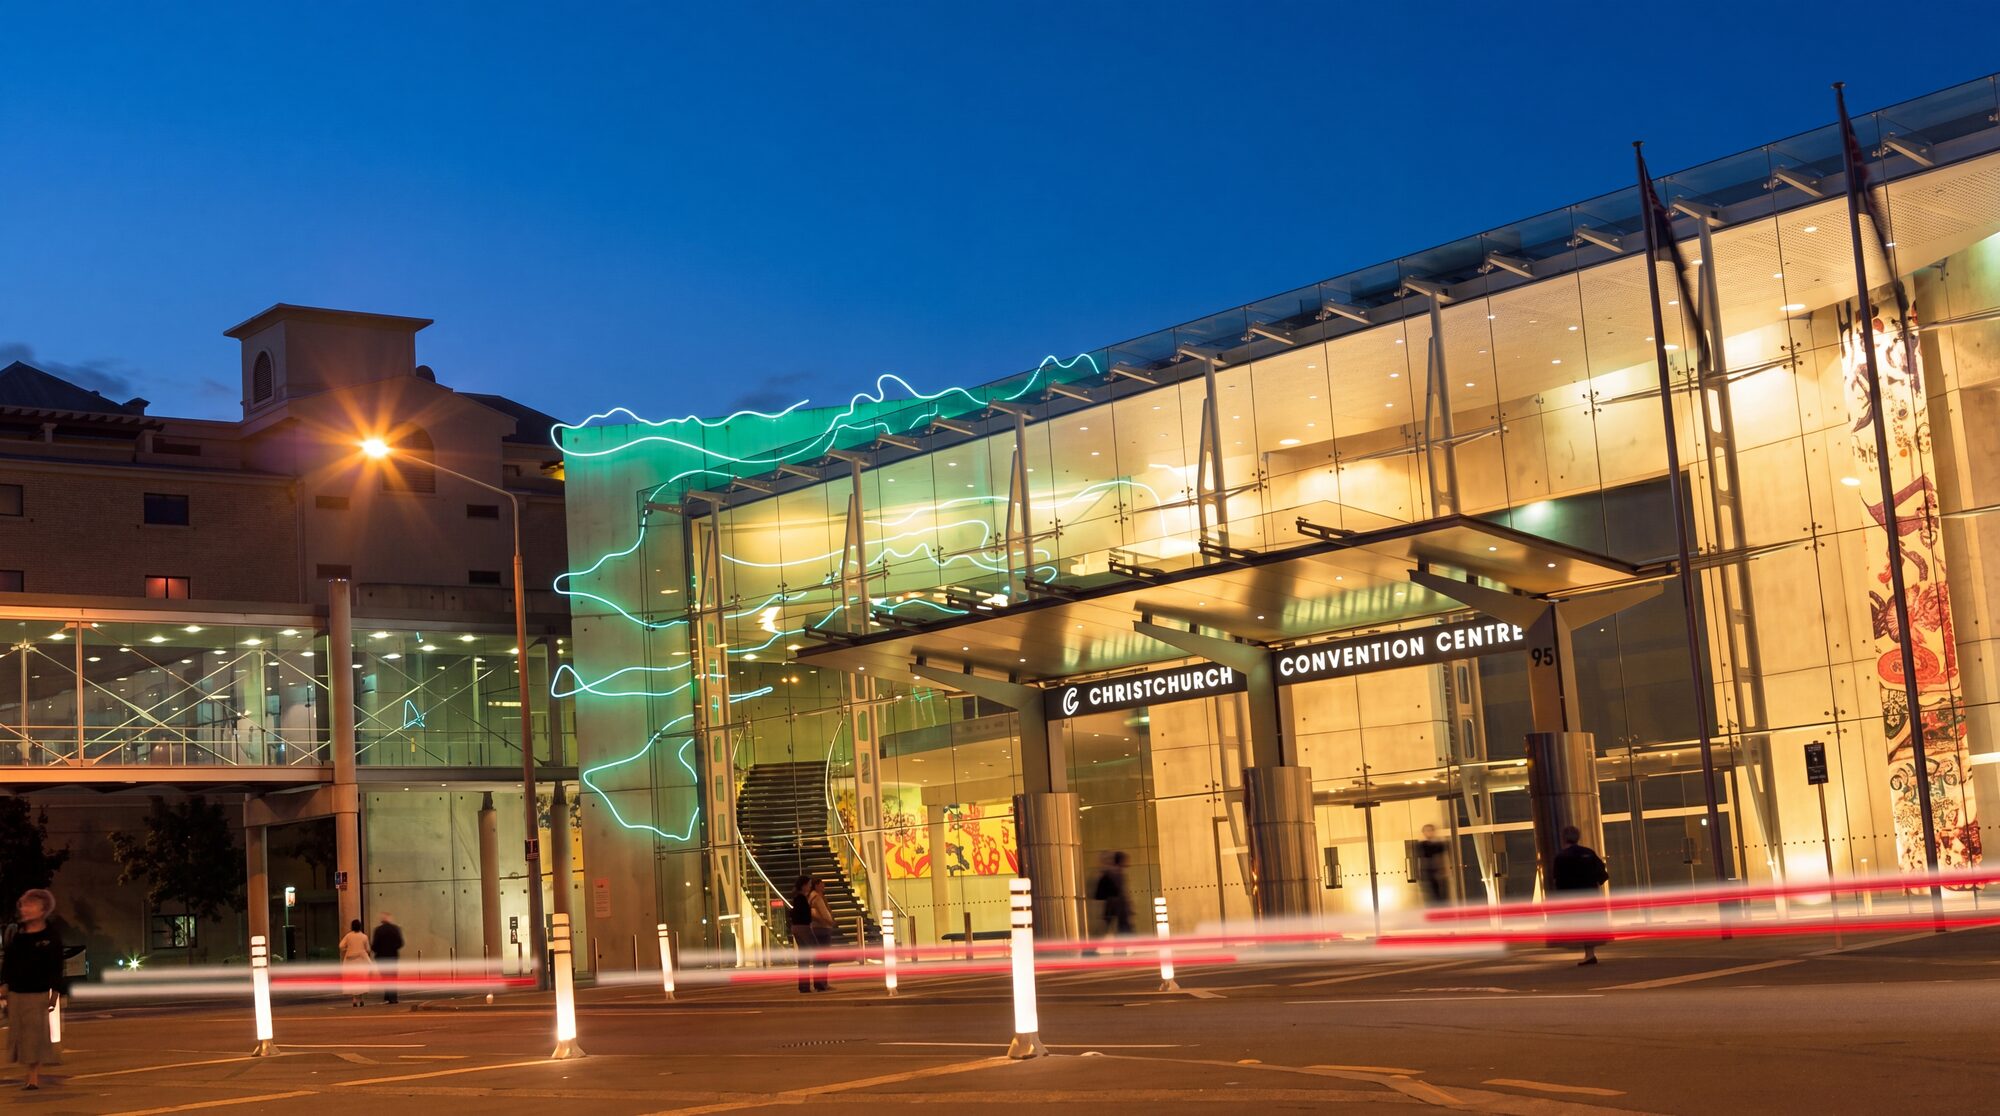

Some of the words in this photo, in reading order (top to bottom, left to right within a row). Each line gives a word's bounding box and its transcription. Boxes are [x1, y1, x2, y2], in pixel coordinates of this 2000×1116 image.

[1089, 666, 1233, 705] CHRISTCHURCH
[1279, 636, 1425, 677] CONVENTION
[1436, 622, 1524, 652] CENTRE
[1531, 647, 1554, 668] 95
